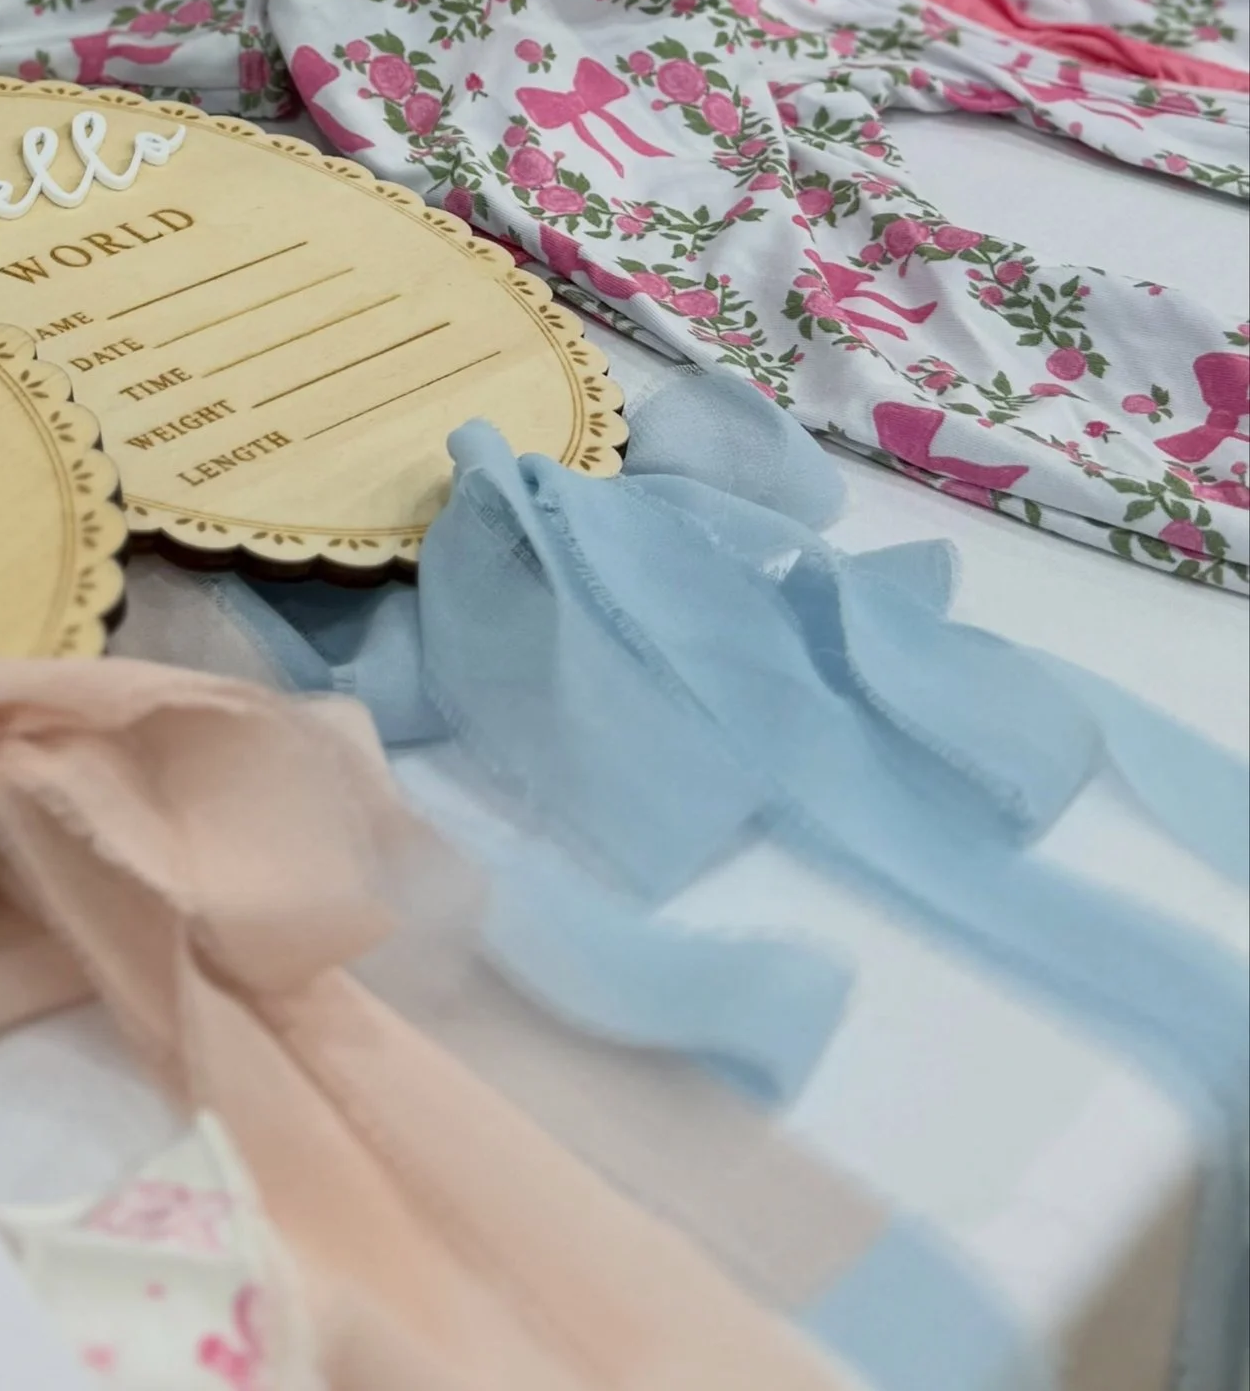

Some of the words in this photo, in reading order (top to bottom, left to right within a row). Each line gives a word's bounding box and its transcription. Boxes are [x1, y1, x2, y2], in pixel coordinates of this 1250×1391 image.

[35, 311, 94, 341] AME
[69, 337, 145, 373] DATE
[119, 367, 193, 402] TIME
[124, 399, 237, 451] WEIGHT
[177, 430, 293, 487] LENGTH
